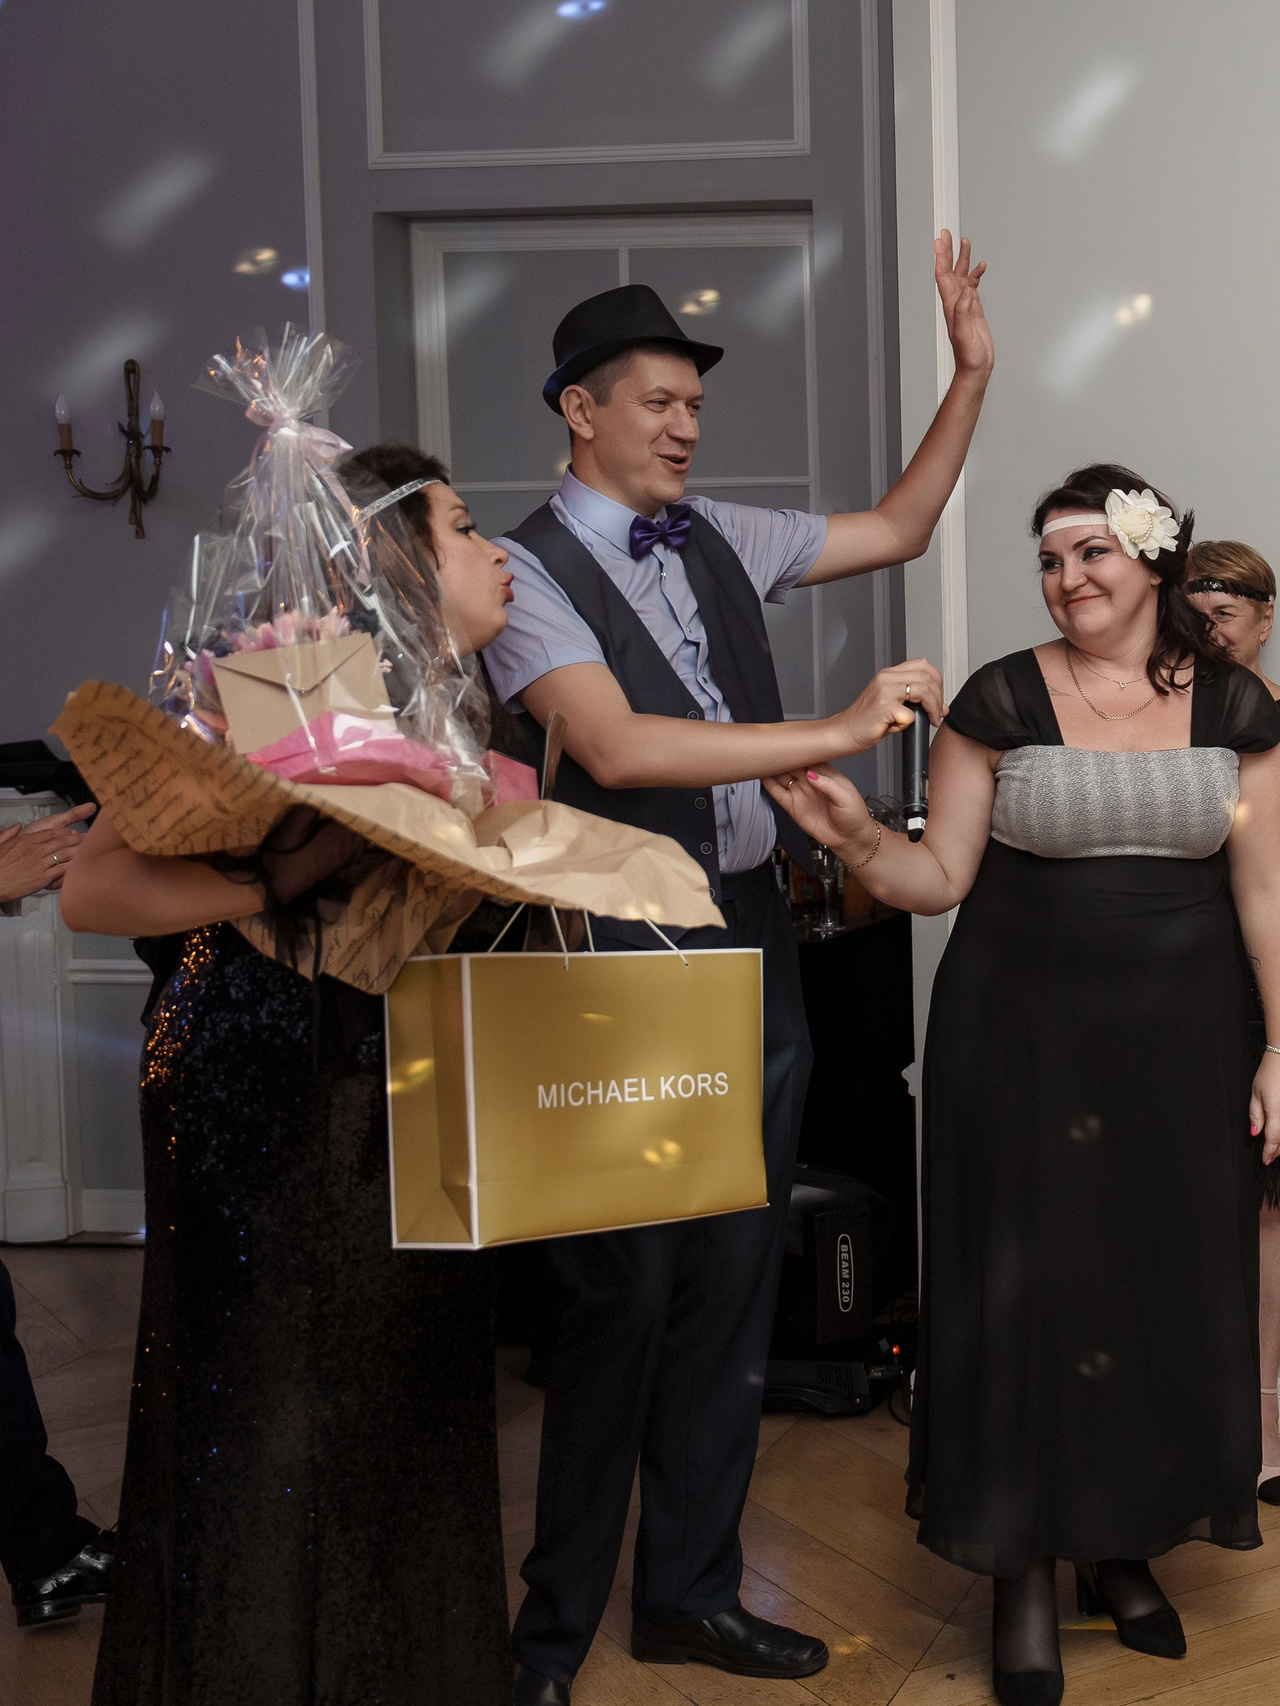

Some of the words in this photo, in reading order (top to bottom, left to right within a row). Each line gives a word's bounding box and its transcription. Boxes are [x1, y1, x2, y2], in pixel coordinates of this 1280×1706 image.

[537, 1077, 655, 1109] MICHAEL
[660, 1072, 729, 1099] KORS
[840, 1244, 850, 1279] BEAM
[841, 1281, 850, 1303] 230
